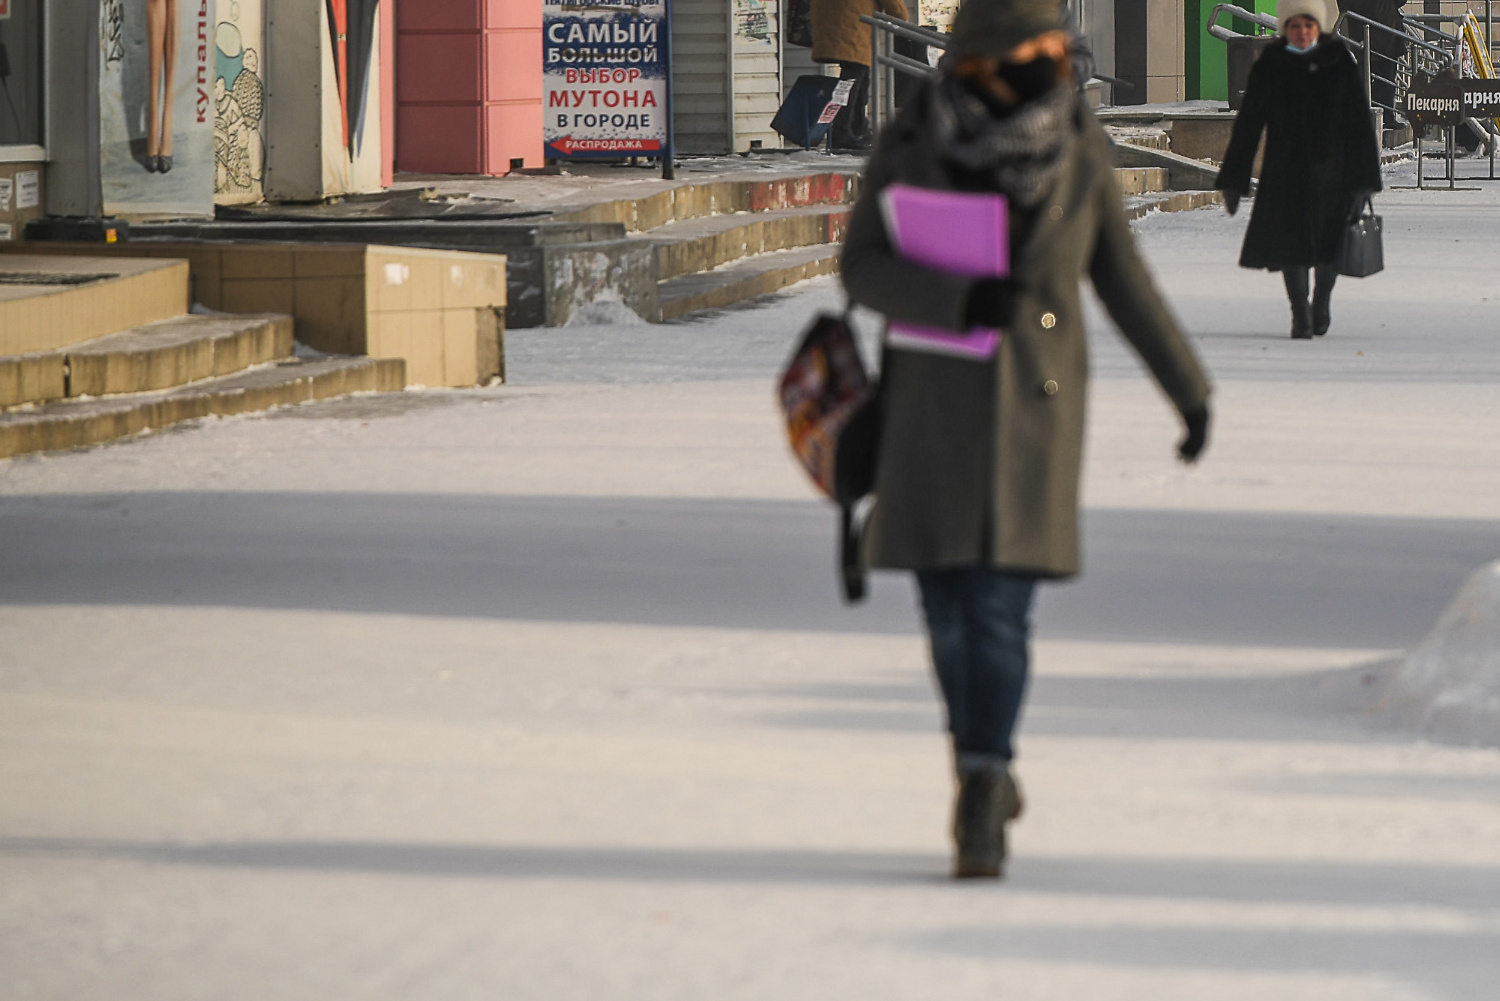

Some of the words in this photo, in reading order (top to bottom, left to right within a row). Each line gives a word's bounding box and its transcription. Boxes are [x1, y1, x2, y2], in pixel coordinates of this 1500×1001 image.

[548, 19, 658, 43] САМЫЙ
[547, 44, 658, 63] БОЛЬШОЙ
[565, 68, 641, 84] ВЫБОР
[549, 89, 658, 108] МУТОНА
[1407, 93, 1460, 116] Пекарня
[557, 114, 568, 127] В
[573, 113, 650, 130] ГОРОДЕ
[565, 140, 642, 150] РАСПРОДАЖА
